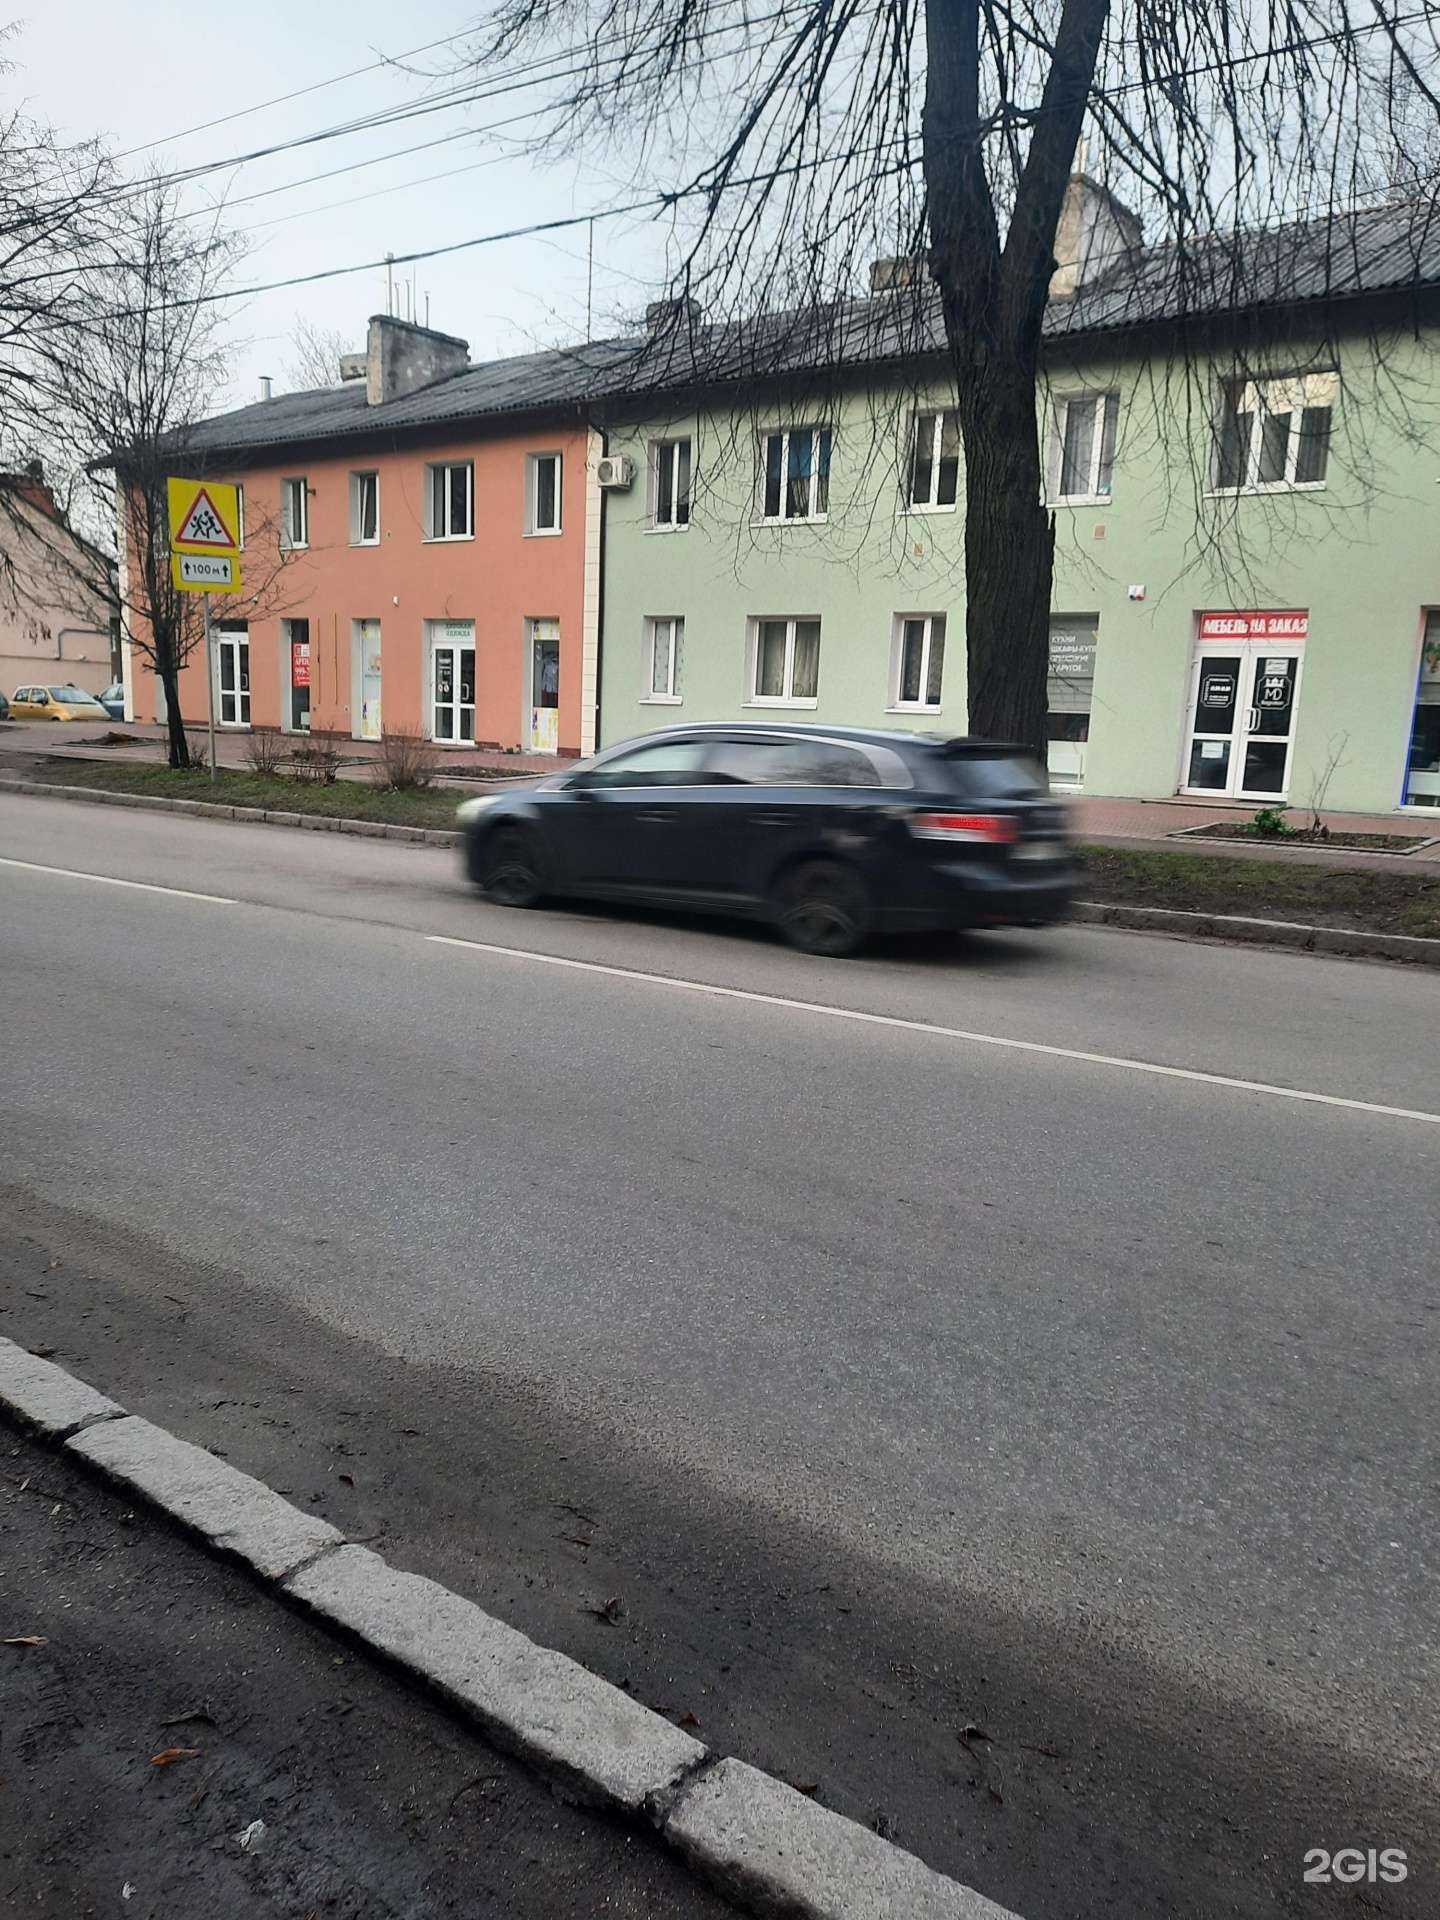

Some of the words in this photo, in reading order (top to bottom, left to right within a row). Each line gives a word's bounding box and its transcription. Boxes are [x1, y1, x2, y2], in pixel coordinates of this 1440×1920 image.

[193, 565, 211, 574] 100
[1203, 619, 1248, 633] МЕБЕЛЬ
[1250, 618, 1266, 633] НА
[1268, 618, 1308, 633] ЗАКАЗ
